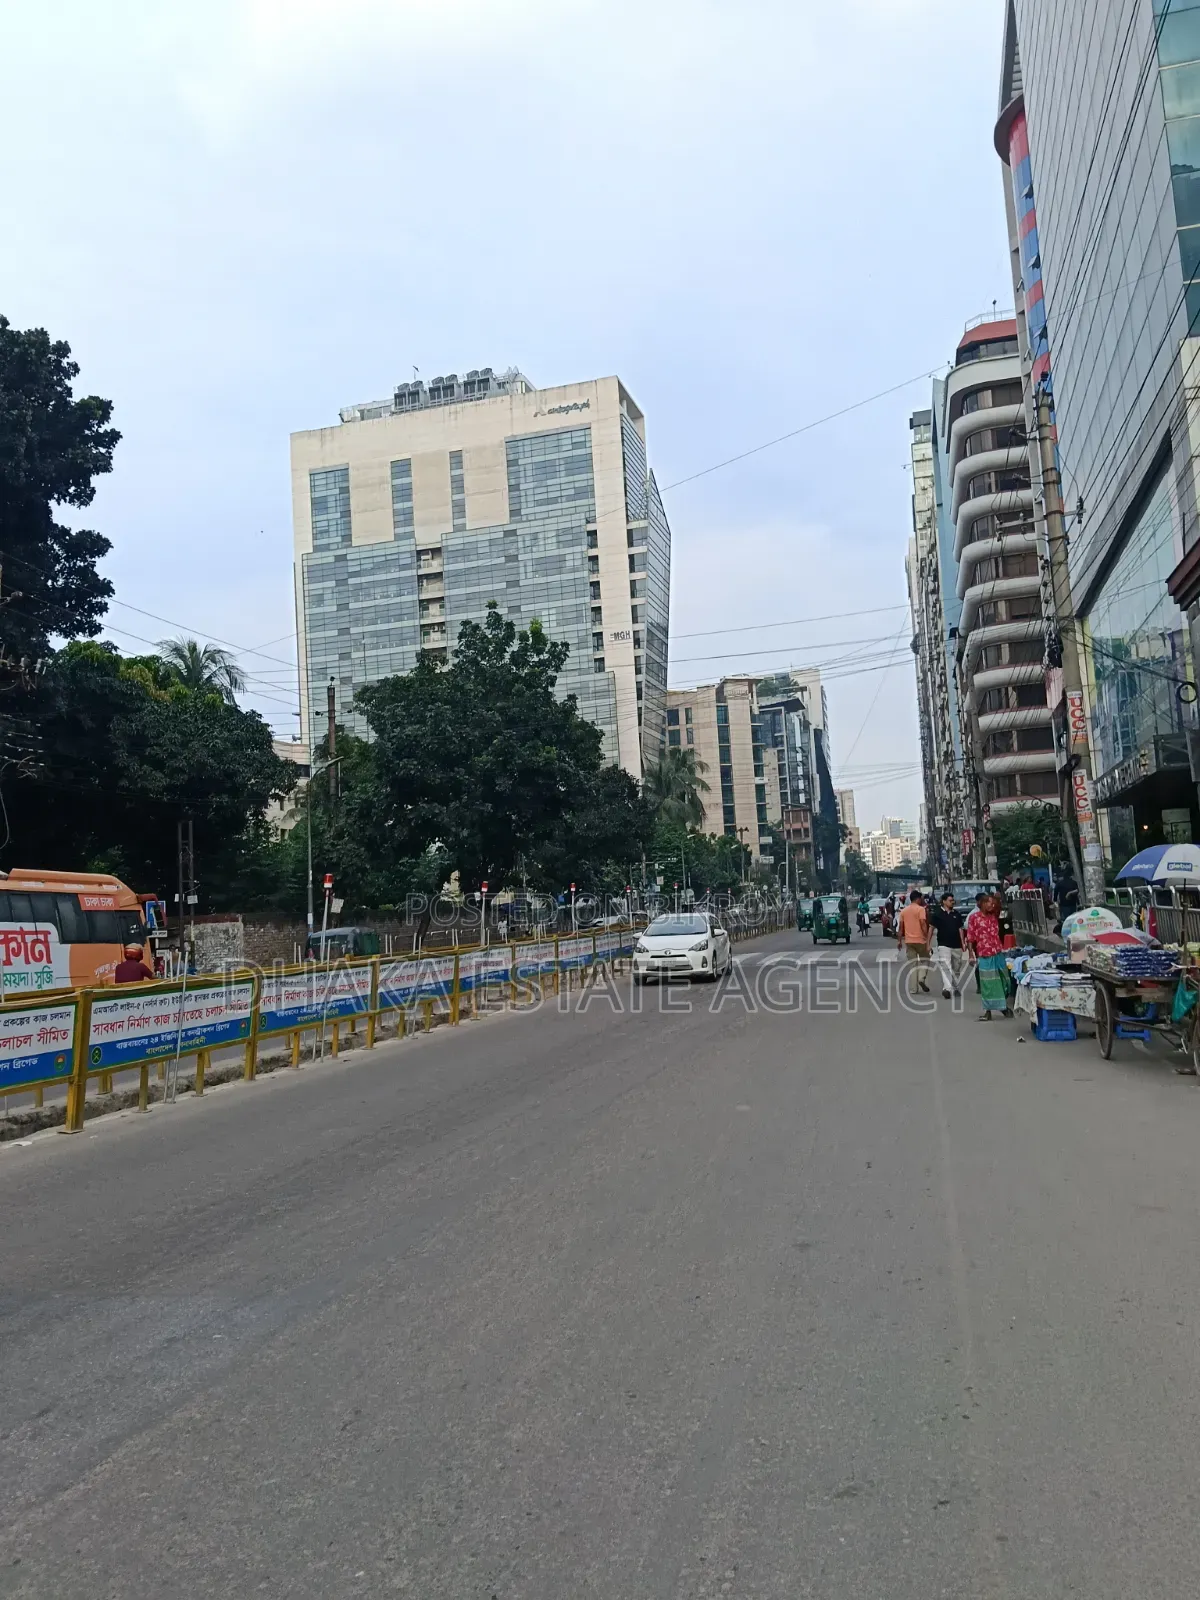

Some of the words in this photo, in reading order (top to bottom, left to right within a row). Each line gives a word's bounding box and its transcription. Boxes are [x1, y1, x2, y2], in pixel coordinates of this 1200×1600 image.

[1073, 775, 1090, 809] UCC
[3, 972, 29, 989] ময়দা
[34, 965, 54, 990] সুজি
[33, 1014, 48, 1023] কাজ
[50, 1011, 71, 1021] চলমান
[93, 1020, 125, 1036] সাবধান
[127, 1013, 151, 1031] নির্মাণ
[153, 1014, 171, 1027] কাজ
[37, 1026, 70, 1045] সীমিত
